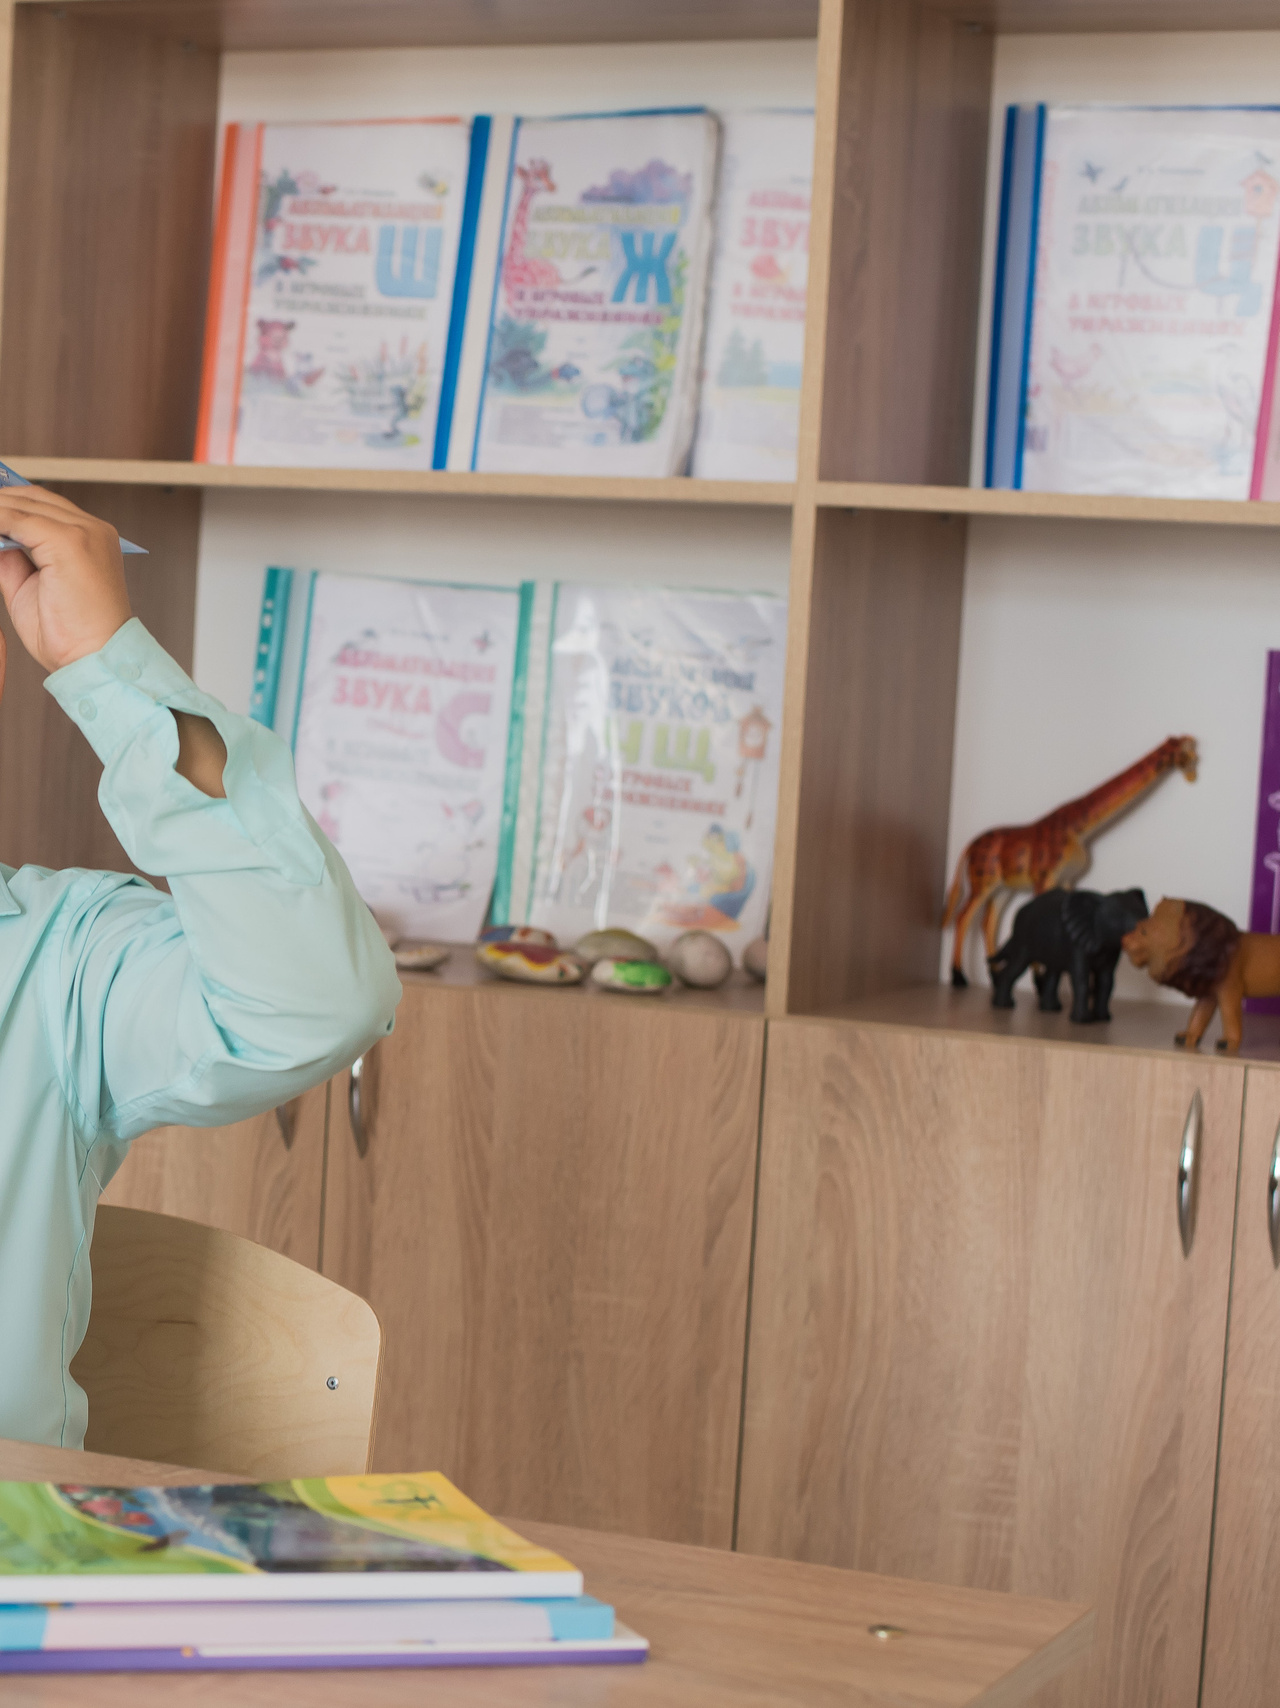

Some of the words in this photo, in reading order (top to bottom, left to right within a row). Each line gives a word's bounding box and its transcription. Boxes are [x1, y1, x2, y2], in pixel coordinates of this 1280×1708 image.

[376, 225, 443, 298] Ш
[610, 231, 677, 303] Ж
[332, 674, 432, 715] ЗВУКА
[436, 691, 492, 770] С
[653, 723, 716, 783] Щ
